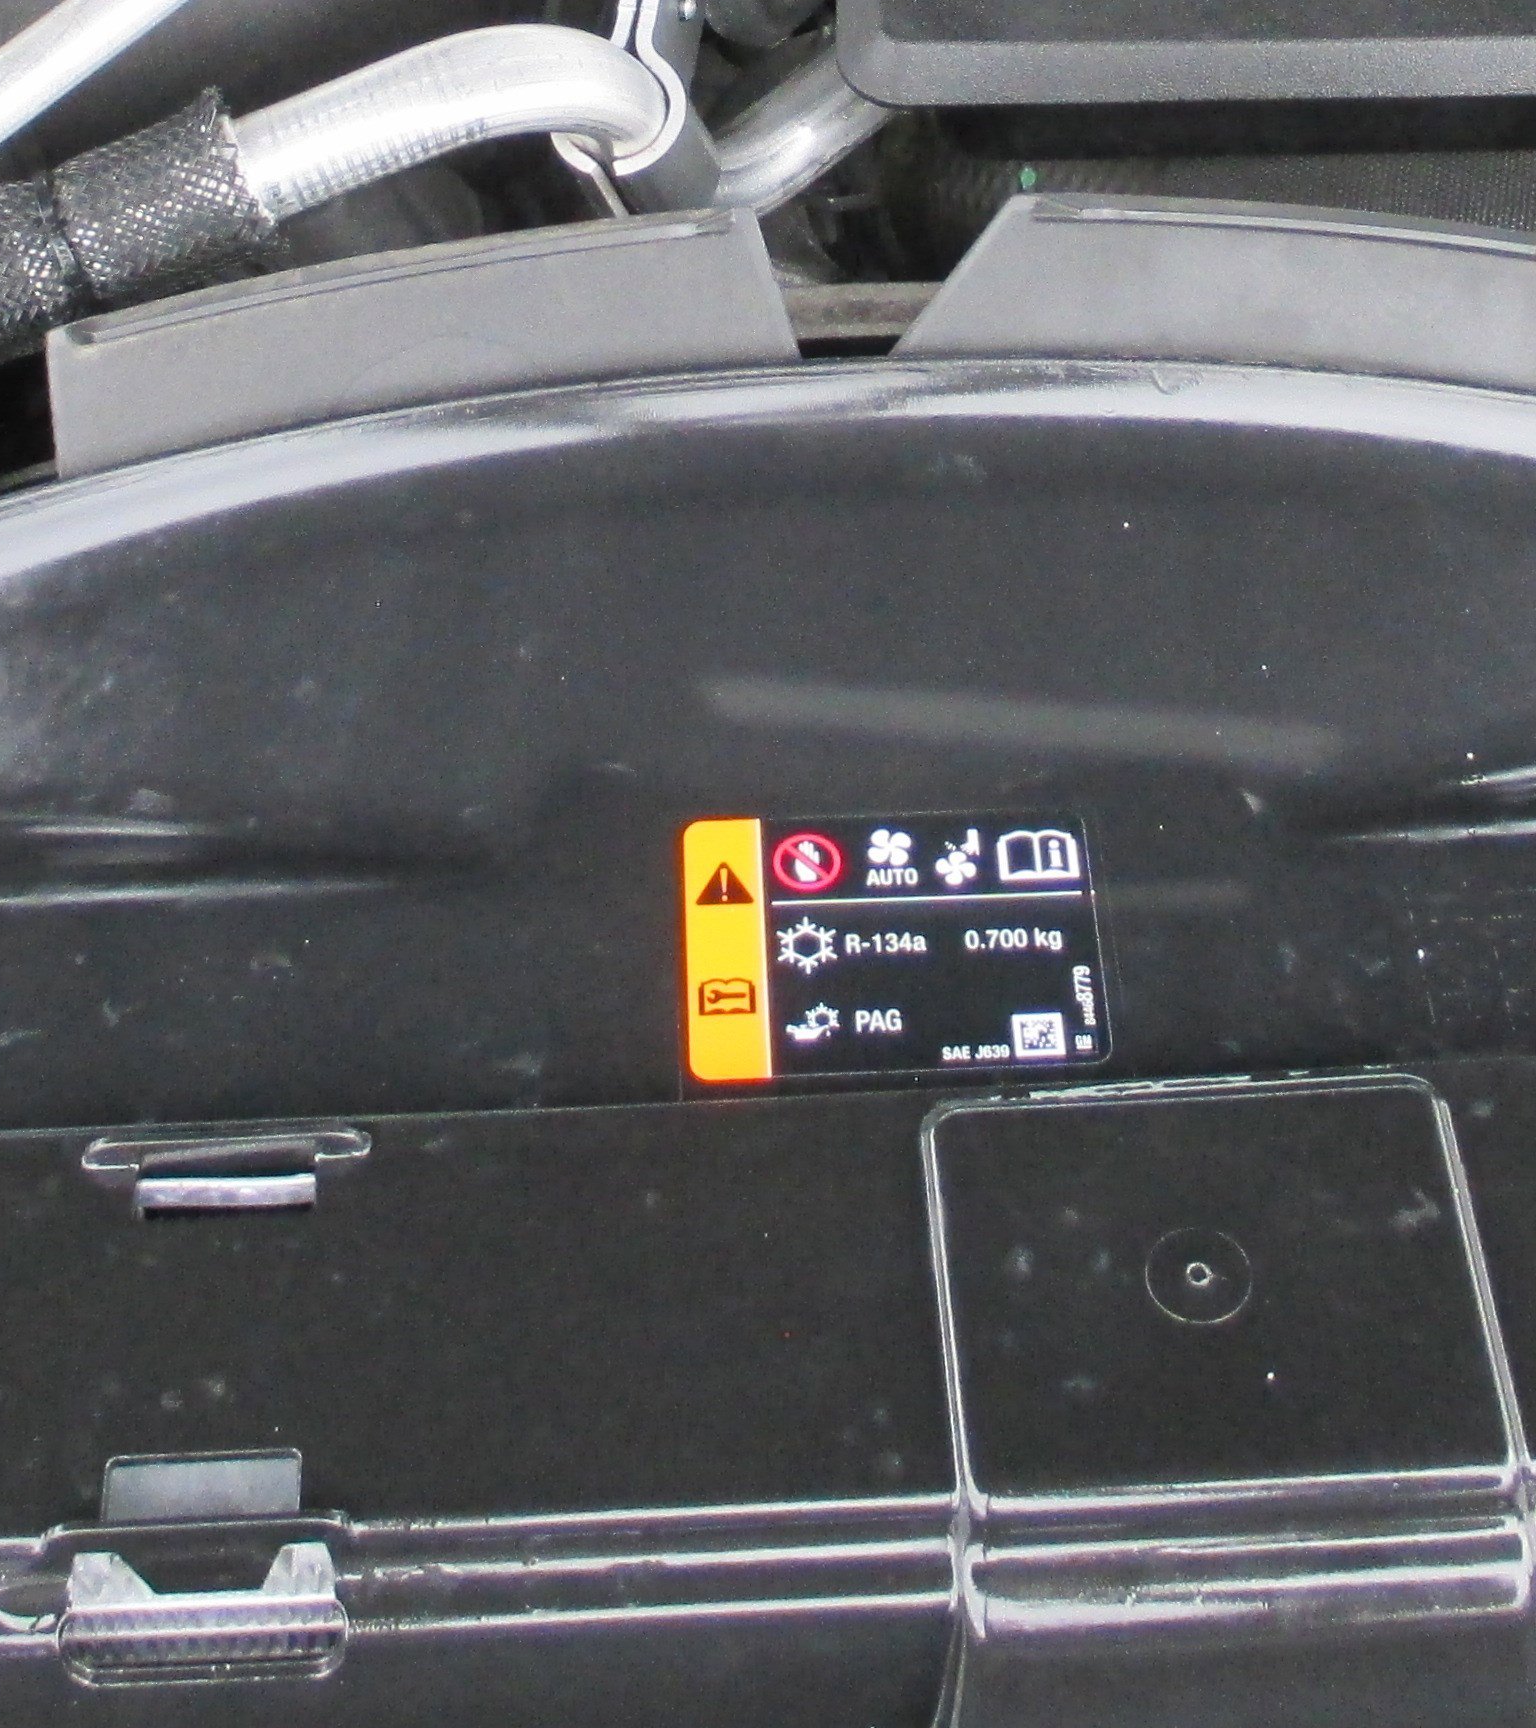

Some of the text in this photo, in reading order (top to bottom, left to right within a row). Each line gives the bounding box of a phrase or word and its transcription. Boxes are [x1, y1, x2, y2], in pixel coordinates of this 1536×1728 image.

[866, 868, 919, 887] AUTO
[844, 927, 1064, 955] R-134a 0.700 kg
[855, 1010, 904, 1034] PAG
[941, 1043, 1011, 1061] SAE J639
